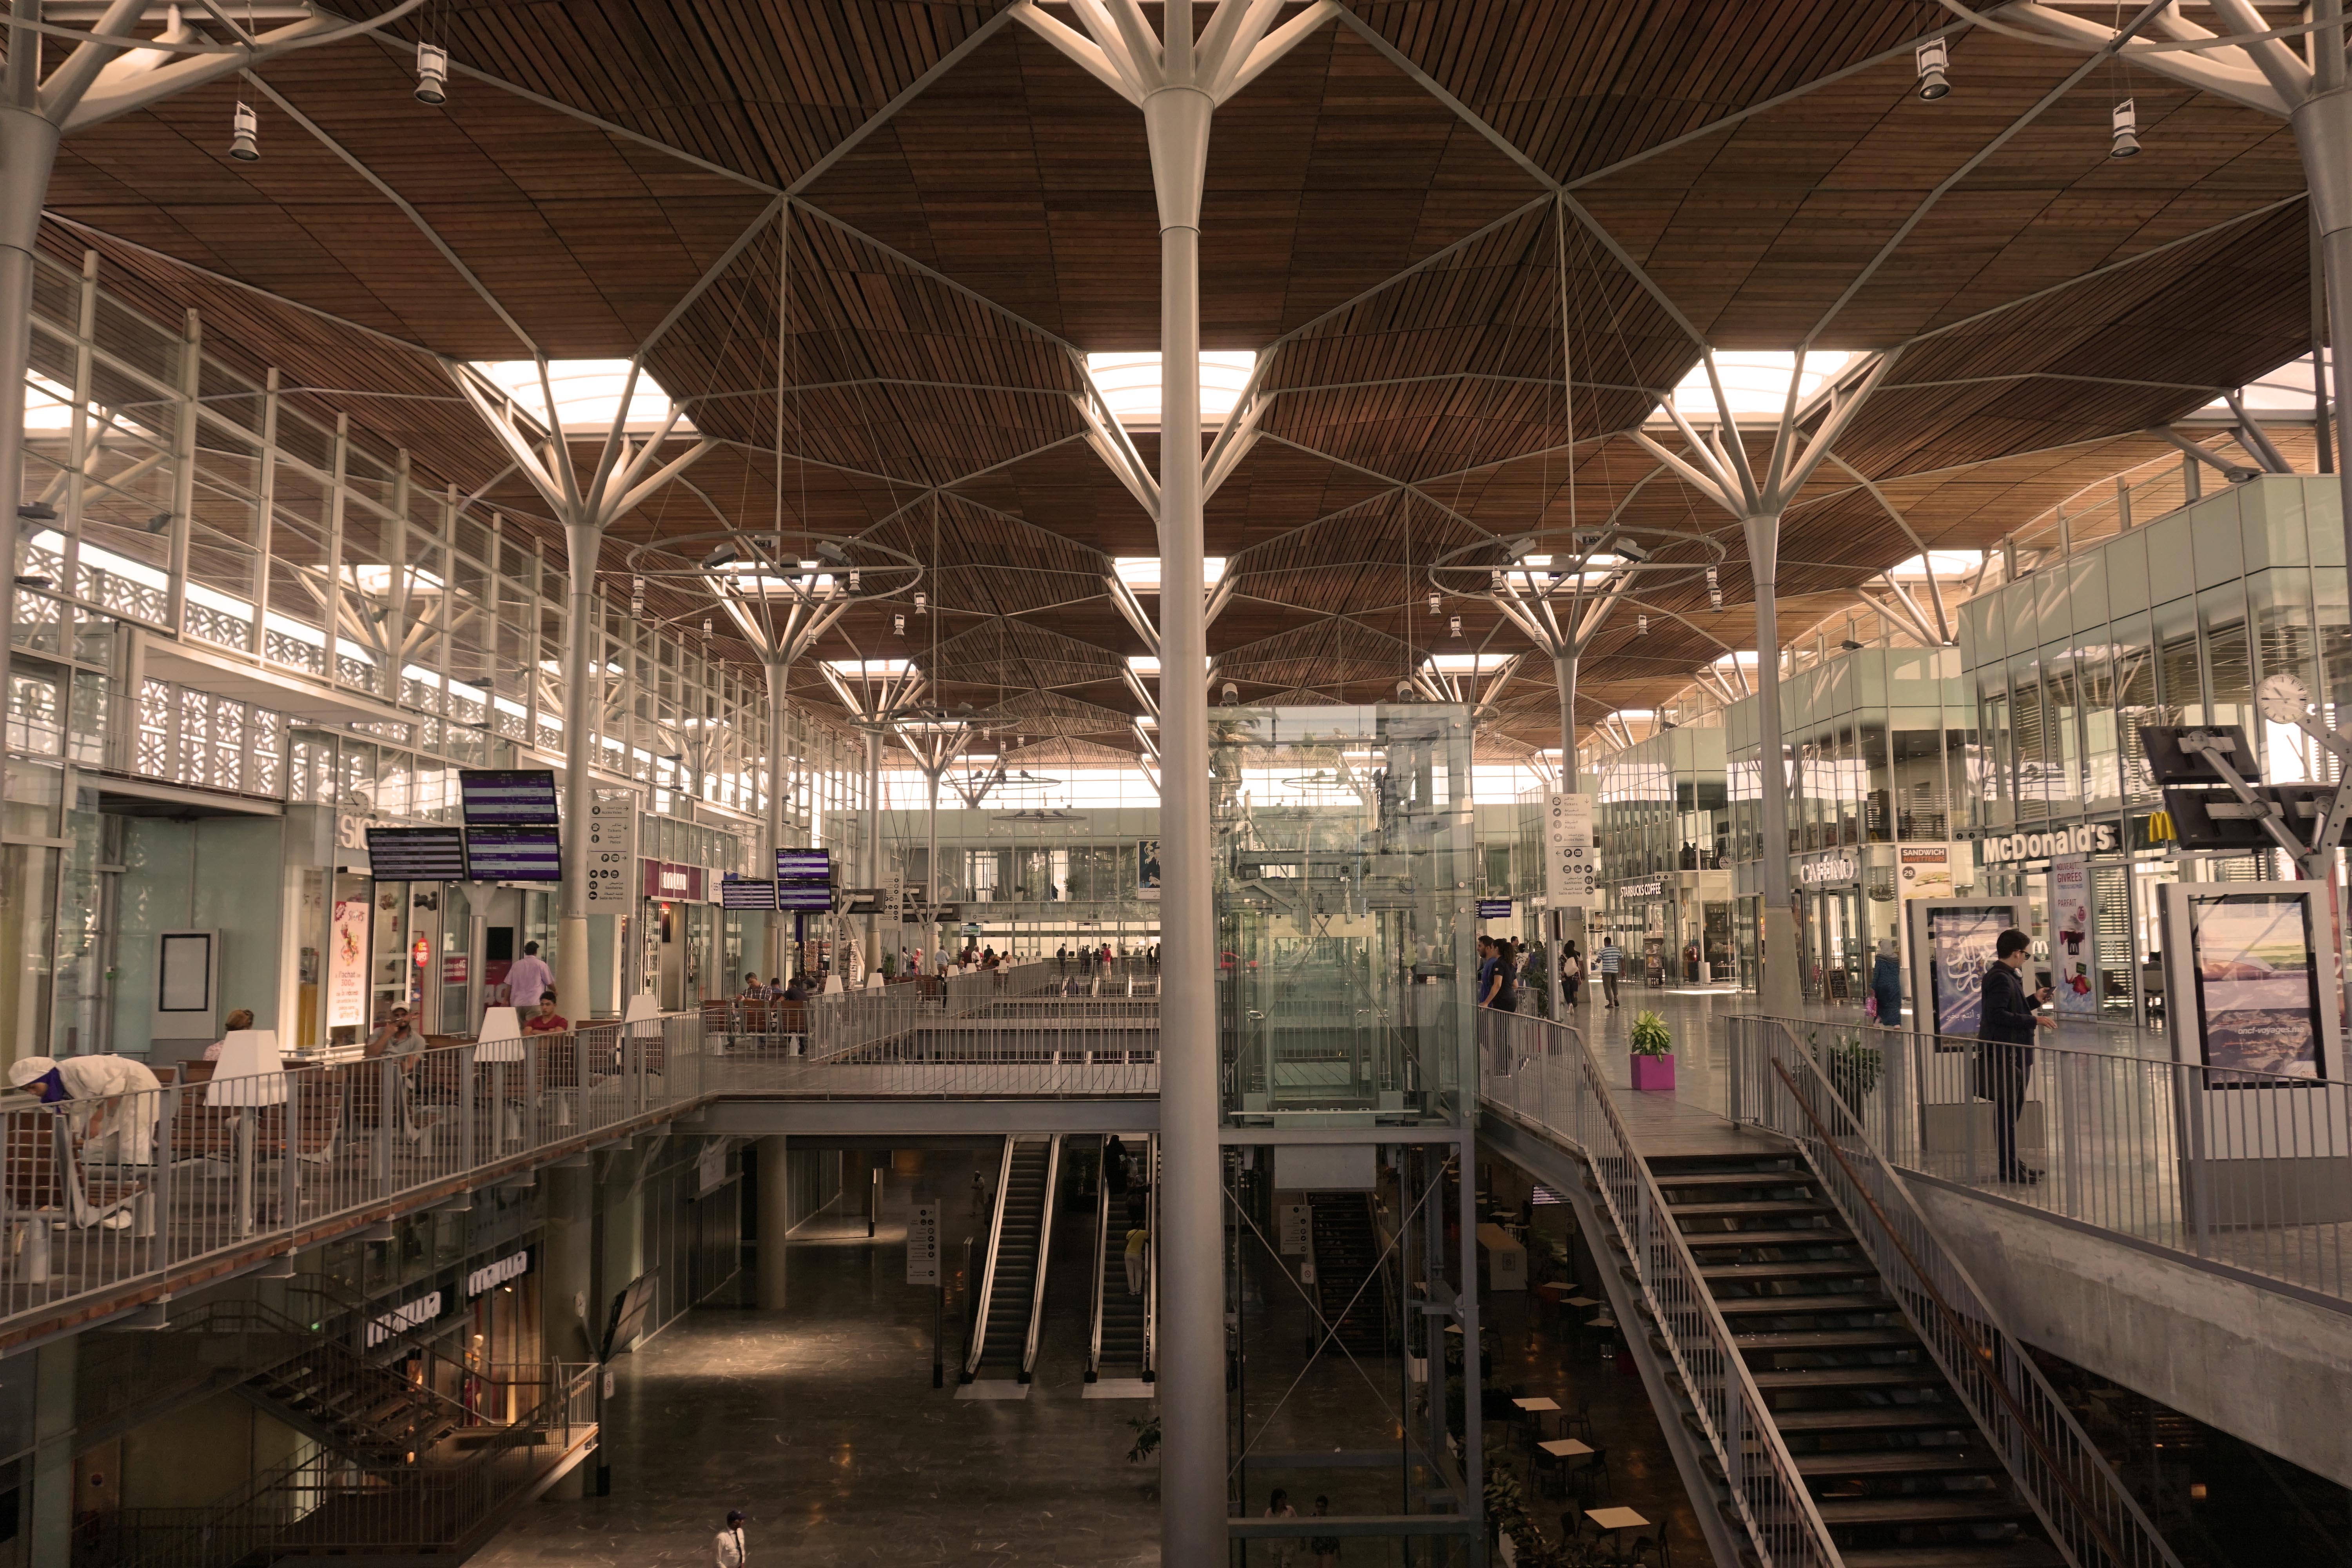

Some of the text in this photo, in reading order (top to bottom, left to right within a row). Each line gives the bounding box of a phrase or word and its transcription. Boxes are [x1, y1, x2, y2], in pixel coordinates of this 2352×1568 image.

[1984, 824, 2111, 863] McDonald's
[2057, 870, 2082, 883] GIVRÉES
[1621, 882, 1661, 897] STARBUCKS COFFEE
[2058, 898, 2076, 907] PARFAIT
[2238, 1026, 2305, 1035] oncf-voyages.ma
